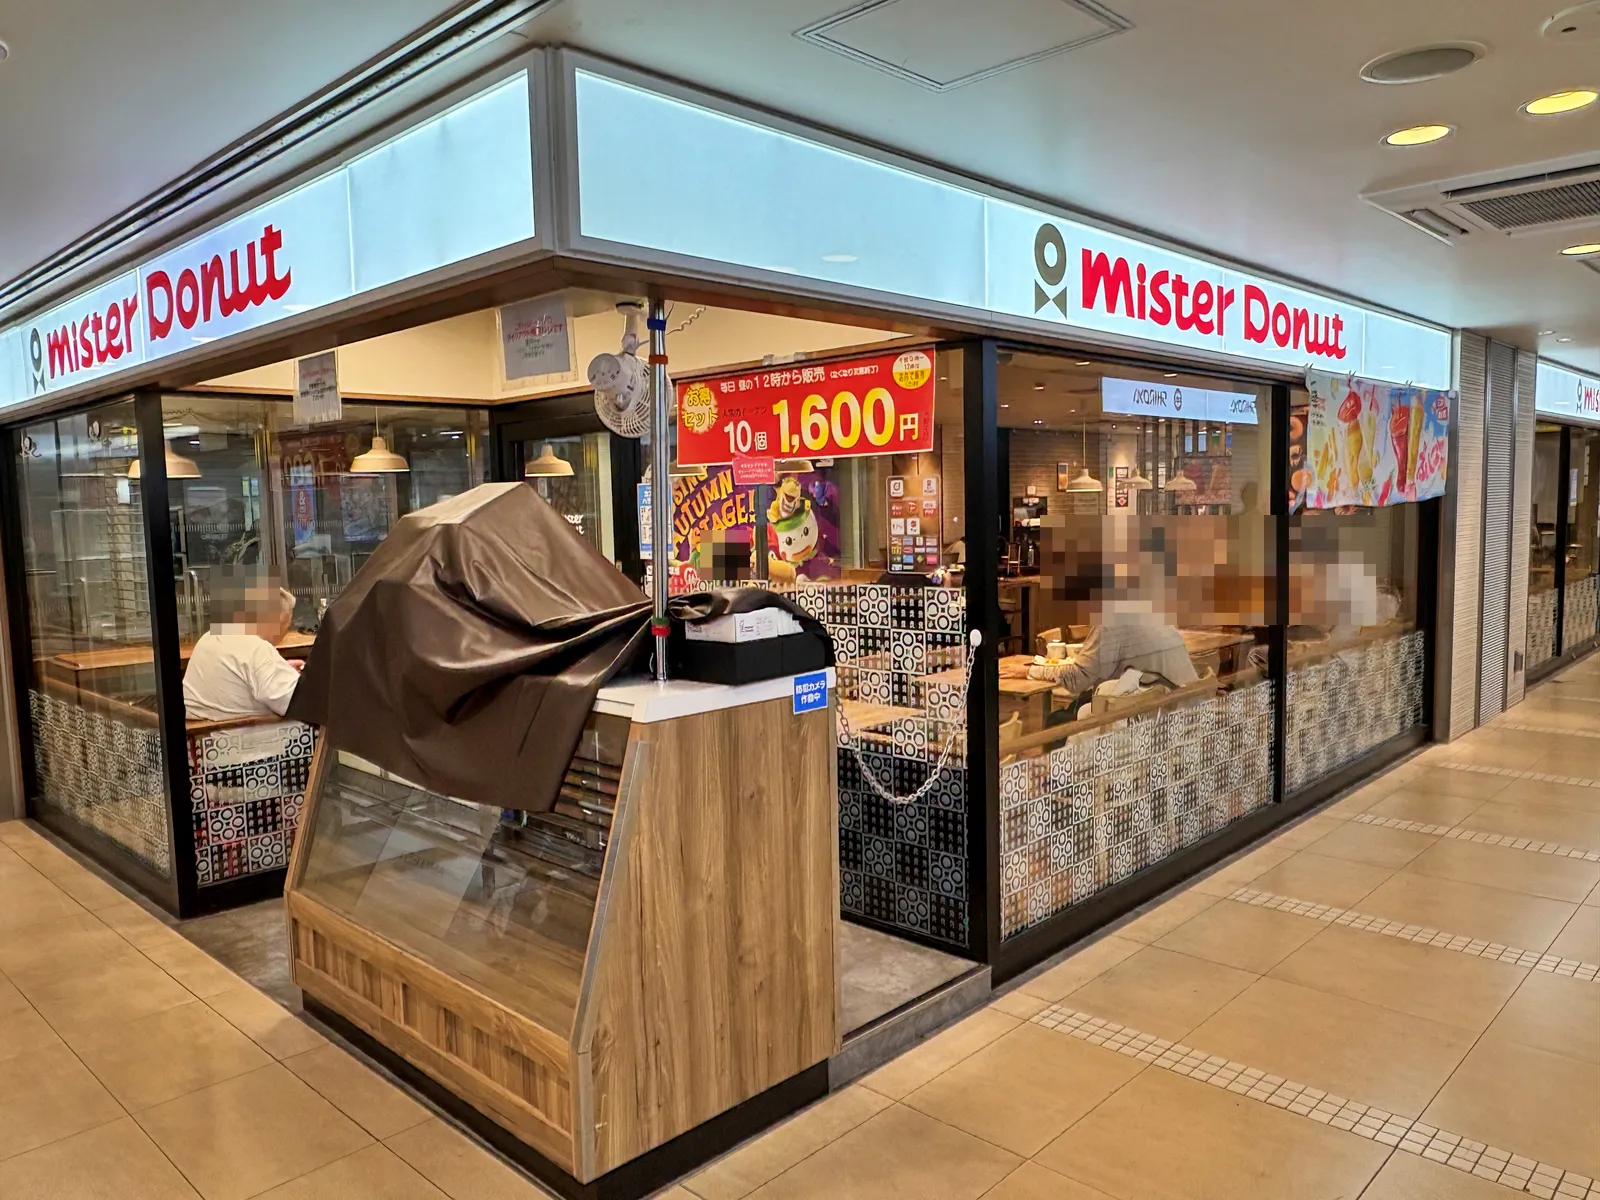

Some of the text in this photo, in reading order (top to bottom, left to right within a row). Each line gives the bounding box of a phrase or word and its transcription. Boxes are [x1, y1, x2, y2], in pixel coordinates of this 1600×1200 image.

[146, 224, 291, 341] Donut
[1244, 284, 1346, 359] Donut
[682, 407, 718, 427] セット
[687, 387, 711, 406] お得
[1584, 386, 1600, 413] mis
[673, 468, 734, 558] UTUMN
